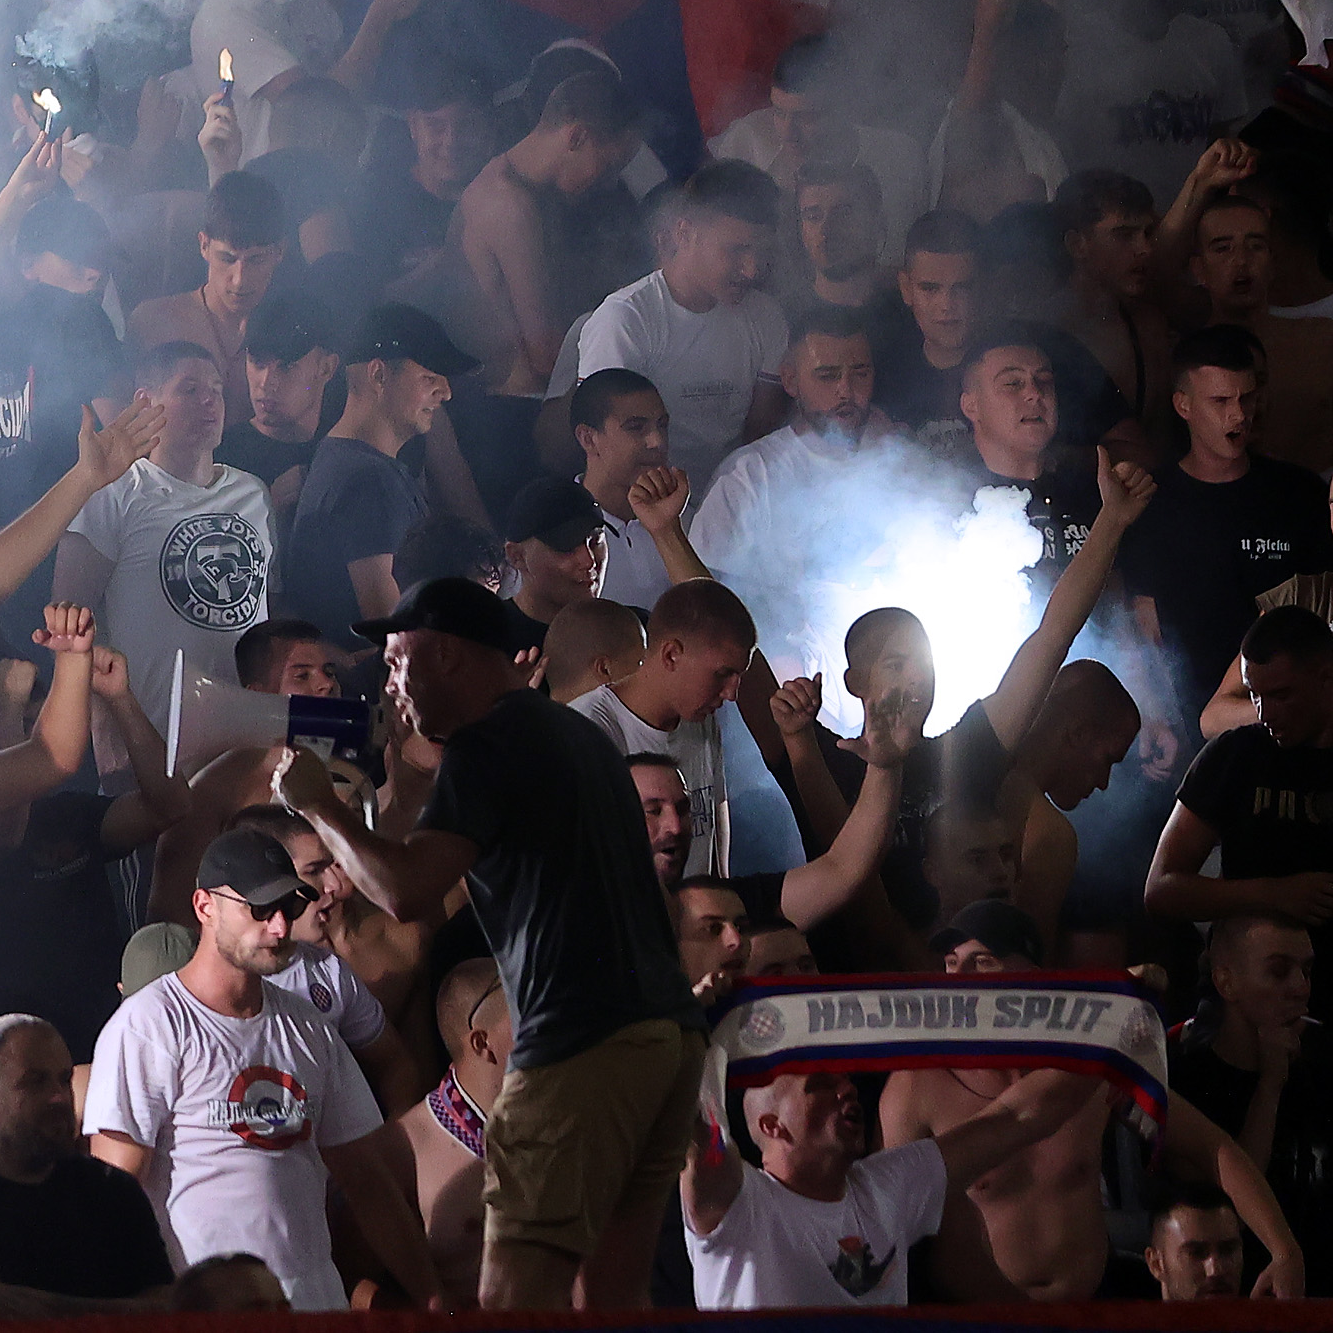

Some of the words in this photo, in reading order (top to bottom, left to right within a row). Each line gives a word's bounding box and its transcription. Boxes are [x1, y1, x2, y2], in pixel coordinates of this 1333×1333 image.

[169, 518, 217, 557] WHITE
[221, 517, 263, 555] BOYS
[182, 592, 259, 625] TORCIDA
[805, 993, 981, 1035] HAJDUK
[992, 994, 1114, 1034] SPLIT
